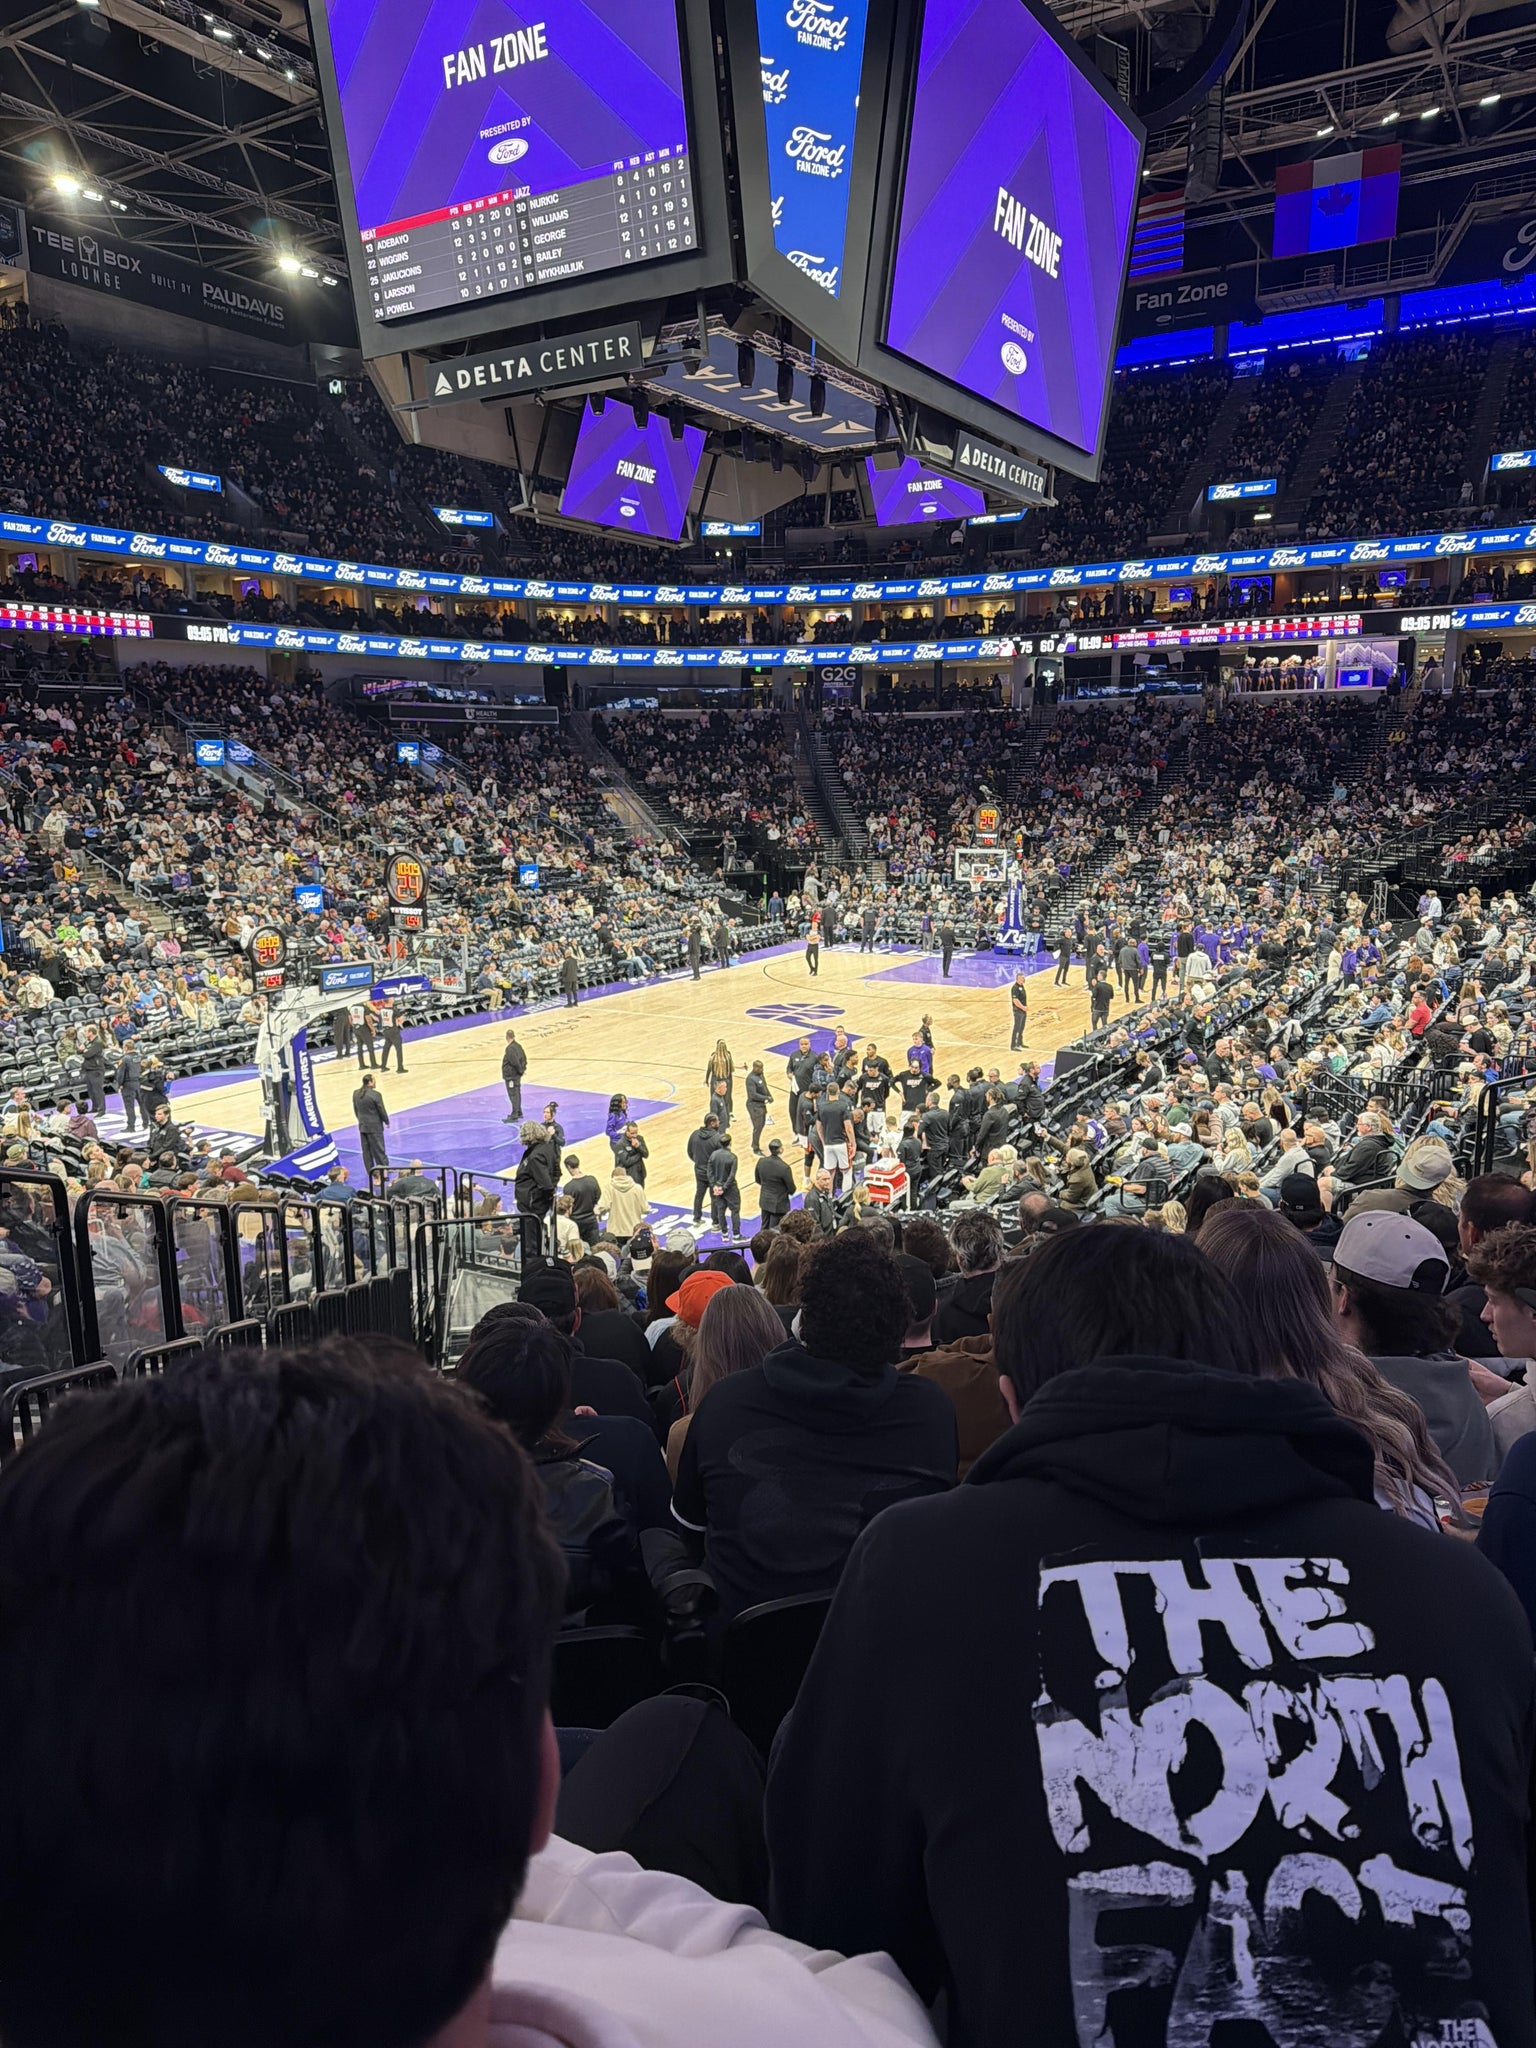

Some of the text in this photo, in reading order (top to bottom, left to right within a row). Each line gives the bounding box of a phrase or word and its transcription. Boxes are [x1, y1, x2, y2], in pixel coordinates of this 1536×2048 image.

[786, 0, 848, 39] Ford
[798, 31, 832, 49] FAN ZONE
[443, 23, 548, 89] FAN ZONE
[480, 116, 531, 139] PRESENTED BY
[786, 127, 846, 167] Ford
[797, 160, 830, 177] FAN ZONE
[514, 186, 530, 200] JAZZ
[516, 159, 684, 213] 30 NURKIC 8 4 11 16 2
[521, 179, 685, 230] 5 WILLIAMS 4 1 0 17 1
[366, 207, 511, 253] 13 ADEBAYO 13 9 2 20 0
[523, 198, 687, 247] 3 GEORGE 12 1 2 19 3
[994, 187, 1062, 279] FAN ZONE
[361, 229, 376, 242] HEAT
[523, 217, 689, 265] 19 BAILEY 12 1 1 15 4
[32, 226, 75, 253] TEE
[103, 249, 141, 274] BOX
[368, 224, 512, 269] 22 WIGGINS 12 3 3 17 1
[370, 242, 515, 285] 25 JAKUCIONIS 5 2 0 10 0
[525, 235, 691, 282] 10 MYKHAILIUK 4 2 1 12 0
[61, 260, 120, 289] LOUNGE
[151, 273, 190, 294] BUILT BY
[374, 259, 517, 301] 9 LARSSON 12 1 1 13 2
[375, 276, 518, 318] 24 POWELL 10 3 4 17 1
[1136, 283, 1228, 311] Fan Zone
[1002, 313, 1034, 343] PRESENTED BY
[457, 337, 631, 389] DELTA CENTER
[1497, 452, 1531, 469] Ford
[164, 467, 190, 486] Ford
[616, 460, 656, 484] FAN ZONE
[972, 452, 1043, 493] DELTA CENTER
[908, 479, 943, 492] FAN ZONE
[1213, 484, 1241, 499] Ford
[438, 509, 463, 523] Ford
[47, 523, 86, 545] Ford
[706, 522, 730, 535] Ford
[130, 535, 166, 556] Ford
[1350, 543, 1390, 560] Ford
[1435, 535, 1477, 553] Ford
[205, 545, 237, 565] Ford
[273, 554, 303, 574] Ford
[1192, 556, 1228, 573] Ford
[396, 570, 426, 588] Ford
[918, 580, 948, 595] Ford
[1050, 569, 1082, 585] Ford
[524, 581, 554, 598] Ford
[655, 586, 685, 602] Ford
[786, 586, 817, 601] Ford
[1401, 615, 1450, 631] 09:05 PM
[187, 625, 228, 643] 09:05 PM
[1020, 641, 1032, 654] 75
[1040, 640, 1054, 652] 60
[1079, 636, 1101, 650] 10:09
[821, 666, 856, 681] G2G
[979, 817, 995, 830] 24
[397, 875, 420, 898] 24
[259, 948, 277, 963] 24
[325, 973, 348, 986] Ford
[299, 1050, 320, 1128] AMERICA FIRST
[1038, 1557, 1375, 1688] THE
[1438, 2018, 1476, 2041] THE
